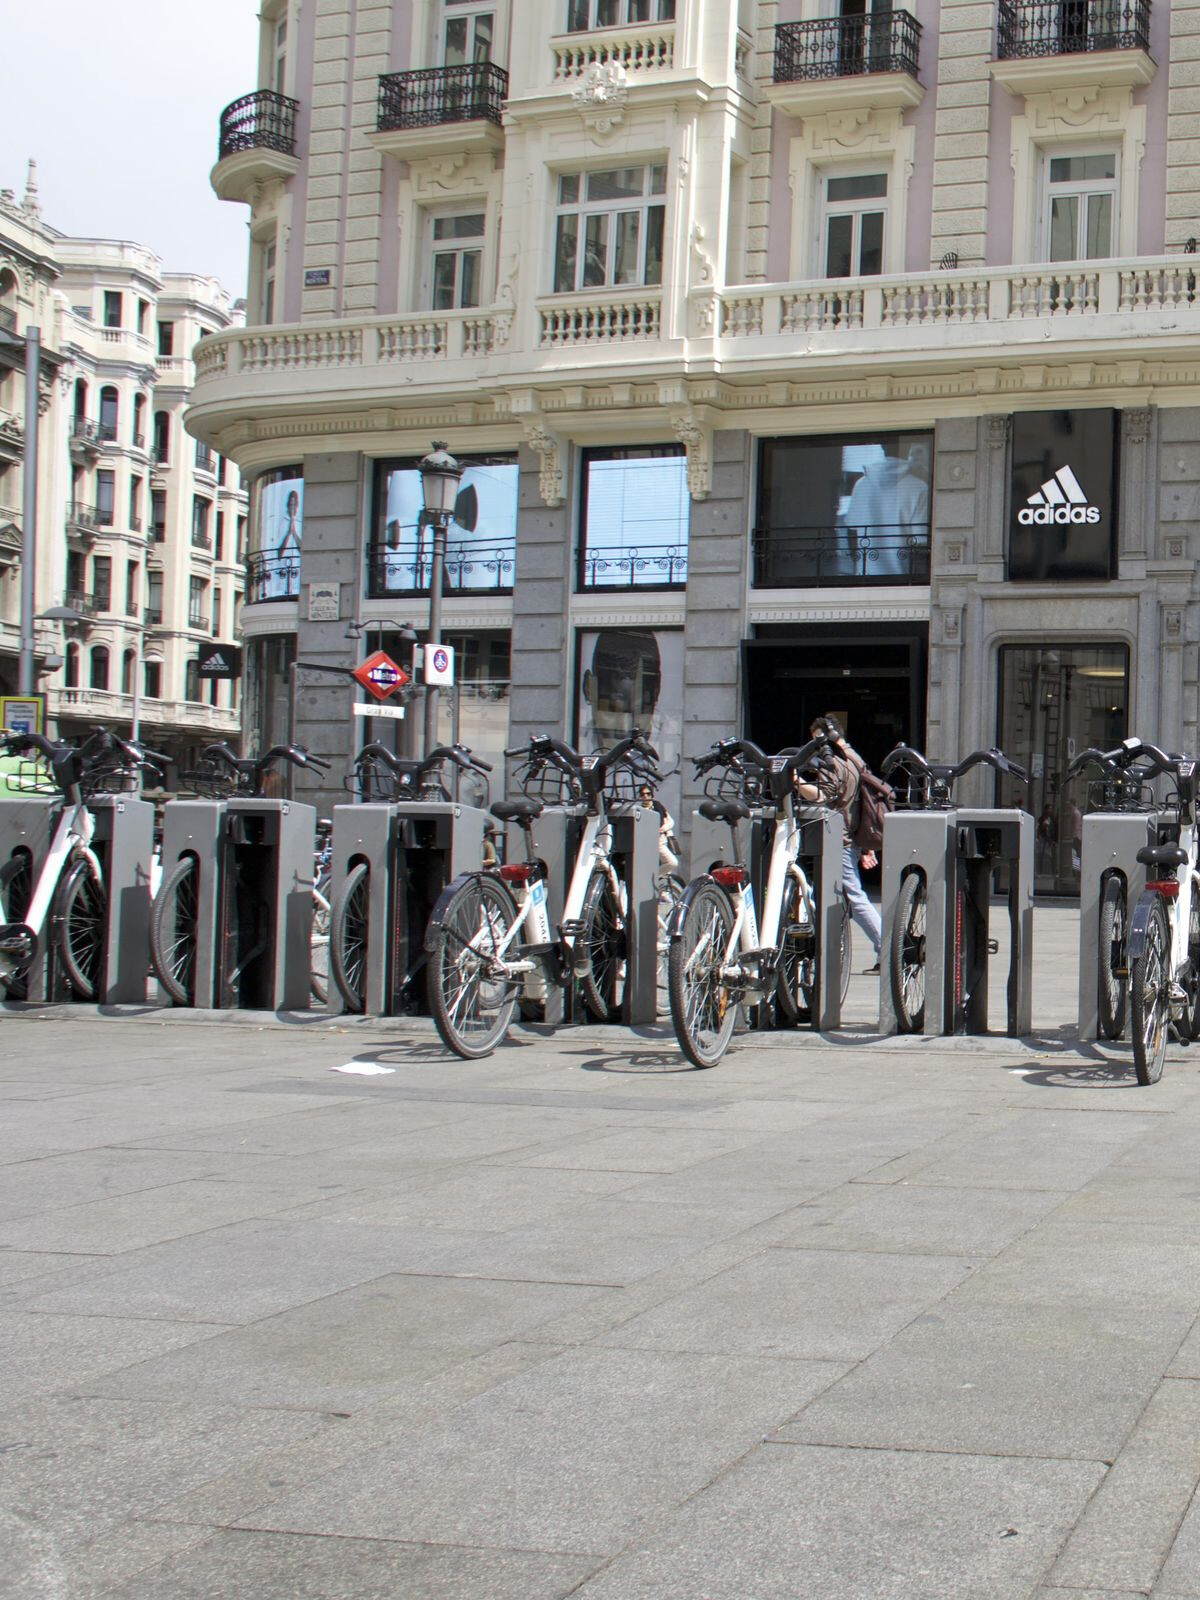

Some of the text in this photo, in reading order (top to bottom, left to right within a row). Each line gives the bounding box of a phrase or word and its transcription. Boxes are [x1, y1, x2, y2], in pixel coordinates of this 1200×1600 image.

[1018, 502, 1101, 525] adidas
[201, 663, 230, 671] adidas
[373, 669, 398, 682] Metro
